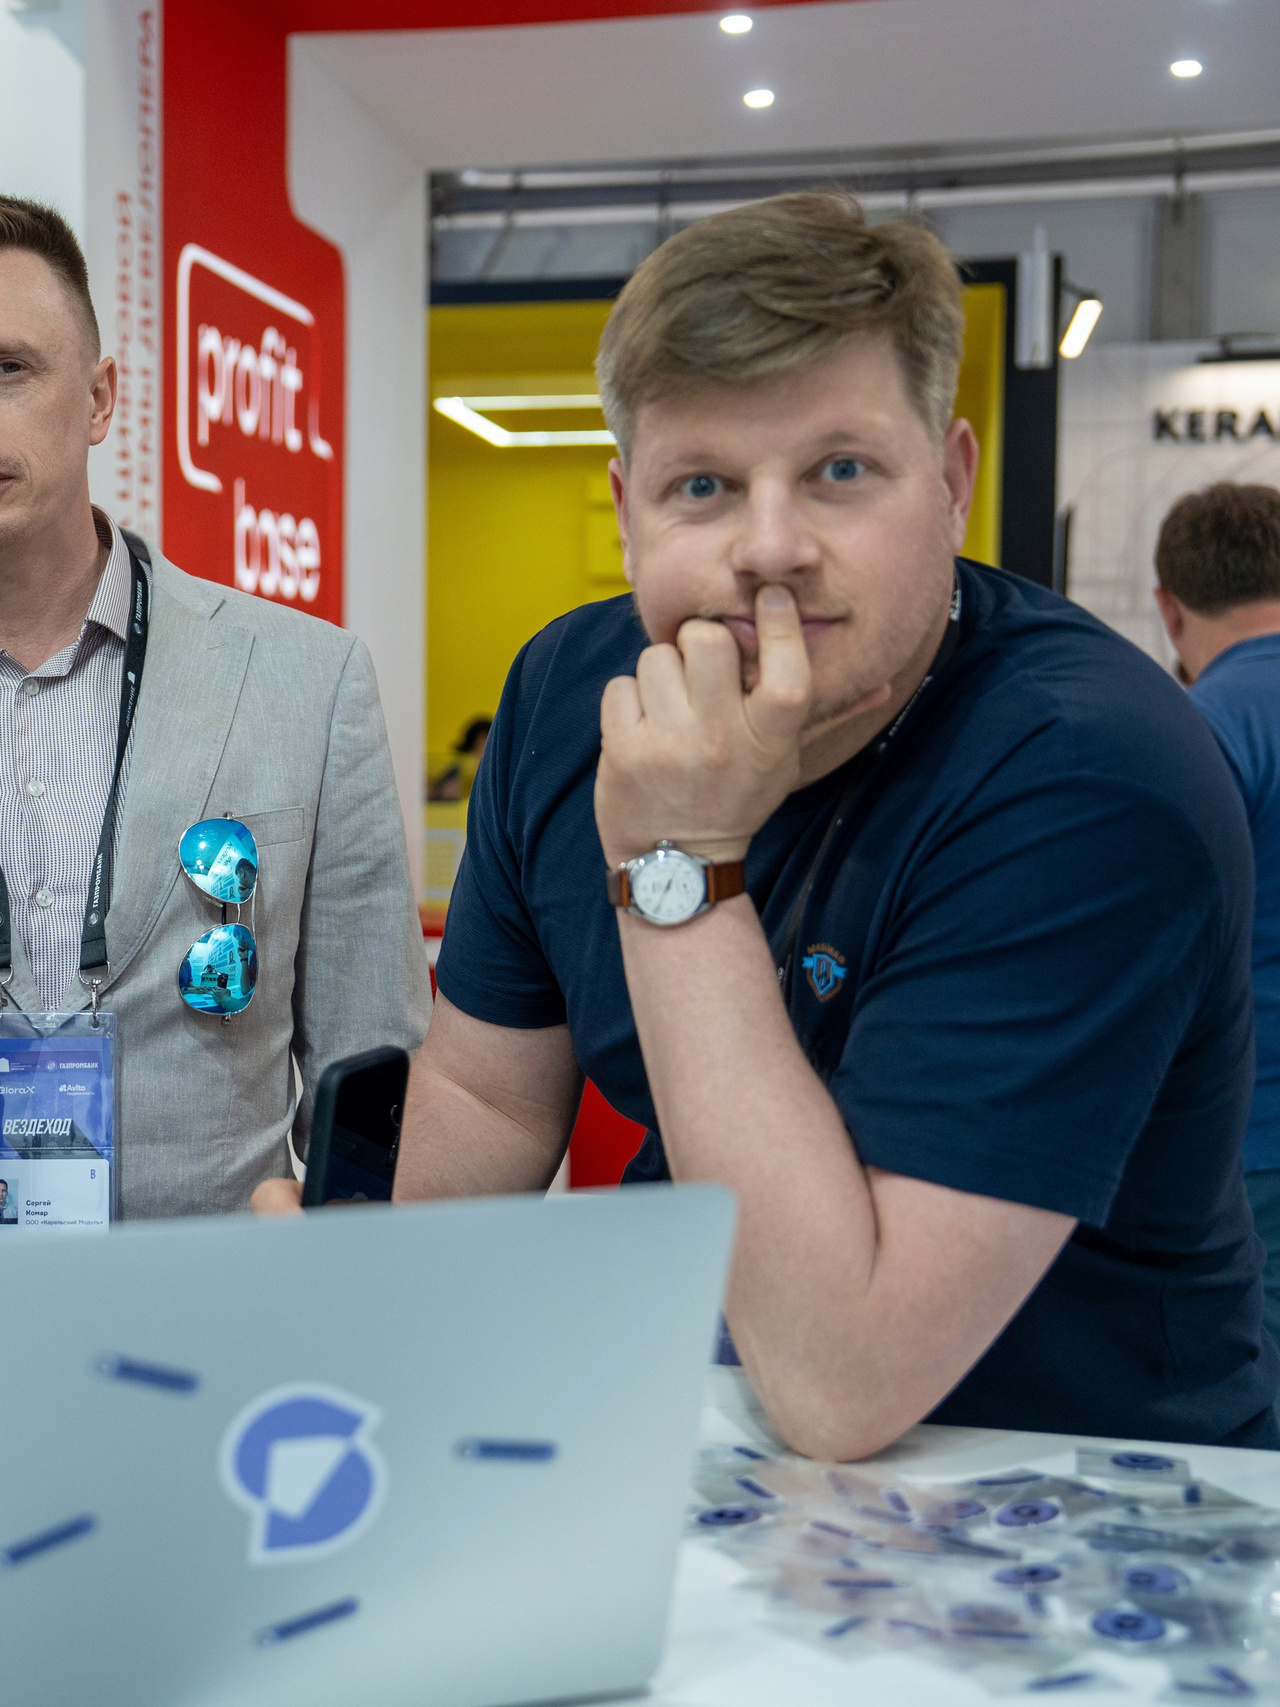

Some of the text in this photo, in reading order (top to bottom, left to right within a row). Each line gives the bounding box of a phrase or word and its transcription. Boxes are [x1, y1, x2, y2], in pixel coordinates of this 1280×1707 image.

[197, 322, 304, 454] profit
[1152, 406, 1280, 443] KERA
[233, 476, 322, 602] base
[92, 852, 103, 908] ГАЗПРОМБАНК
[67, 1084, 86, 1092] Avito
[2, 1118, 72, 1136] ВЕЗДЕХОД
[25, 1199, 51, 1207] Сергей
